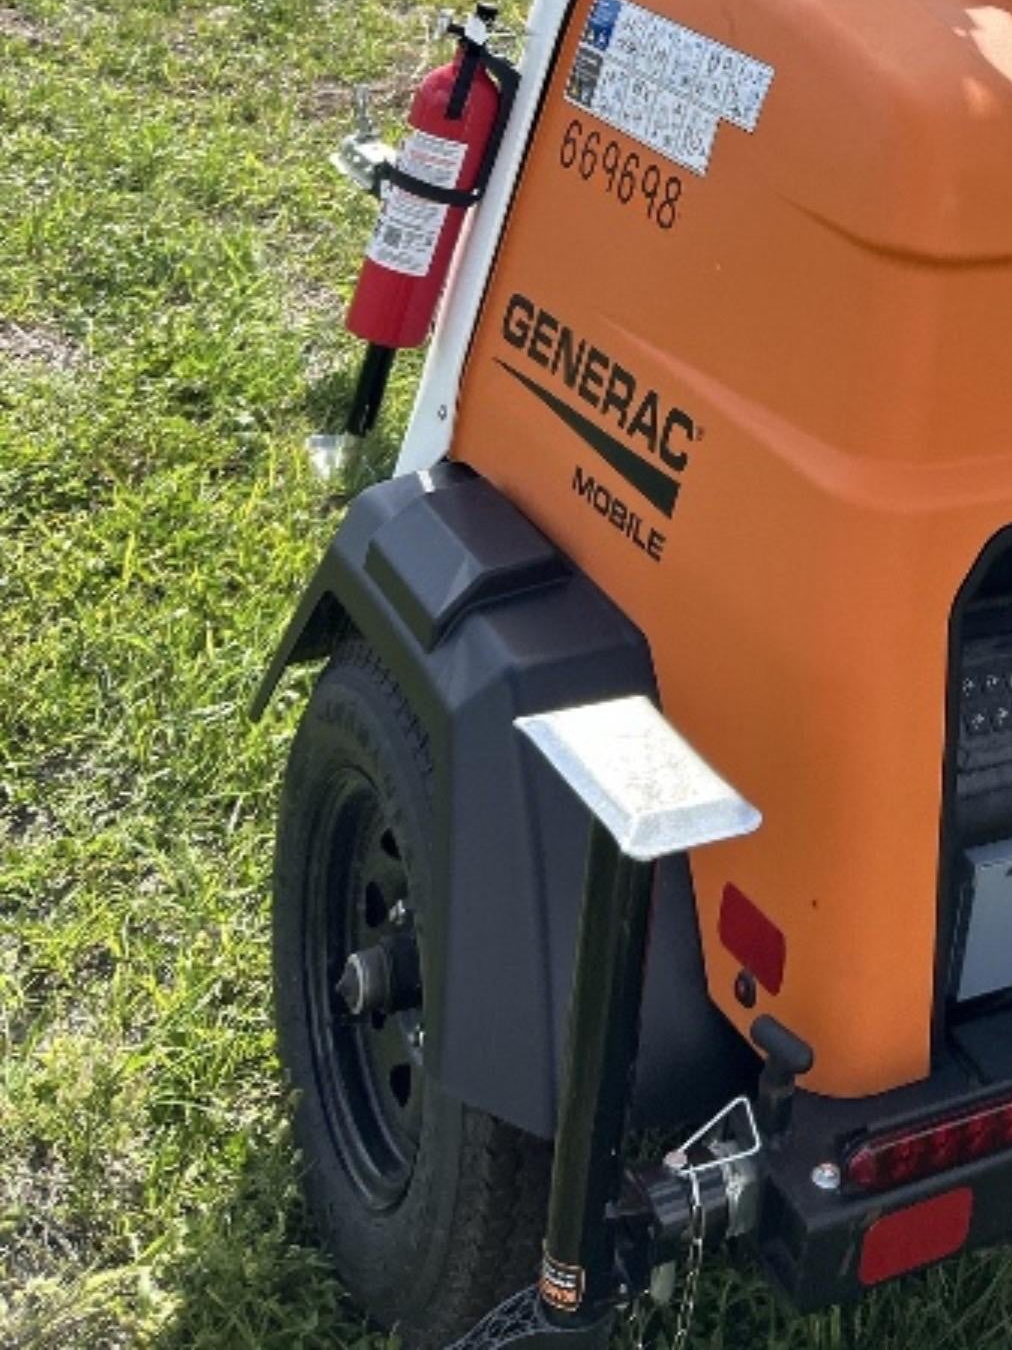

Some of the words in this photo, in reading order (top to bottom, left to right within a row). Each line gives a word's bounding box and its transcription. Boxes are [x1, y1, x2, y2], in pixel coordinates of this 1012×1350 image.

[559, 119, 682, 229] 669698
[503, 293, 694, 472] GENERAC
[572, 467, 666, 561] MOBILE
